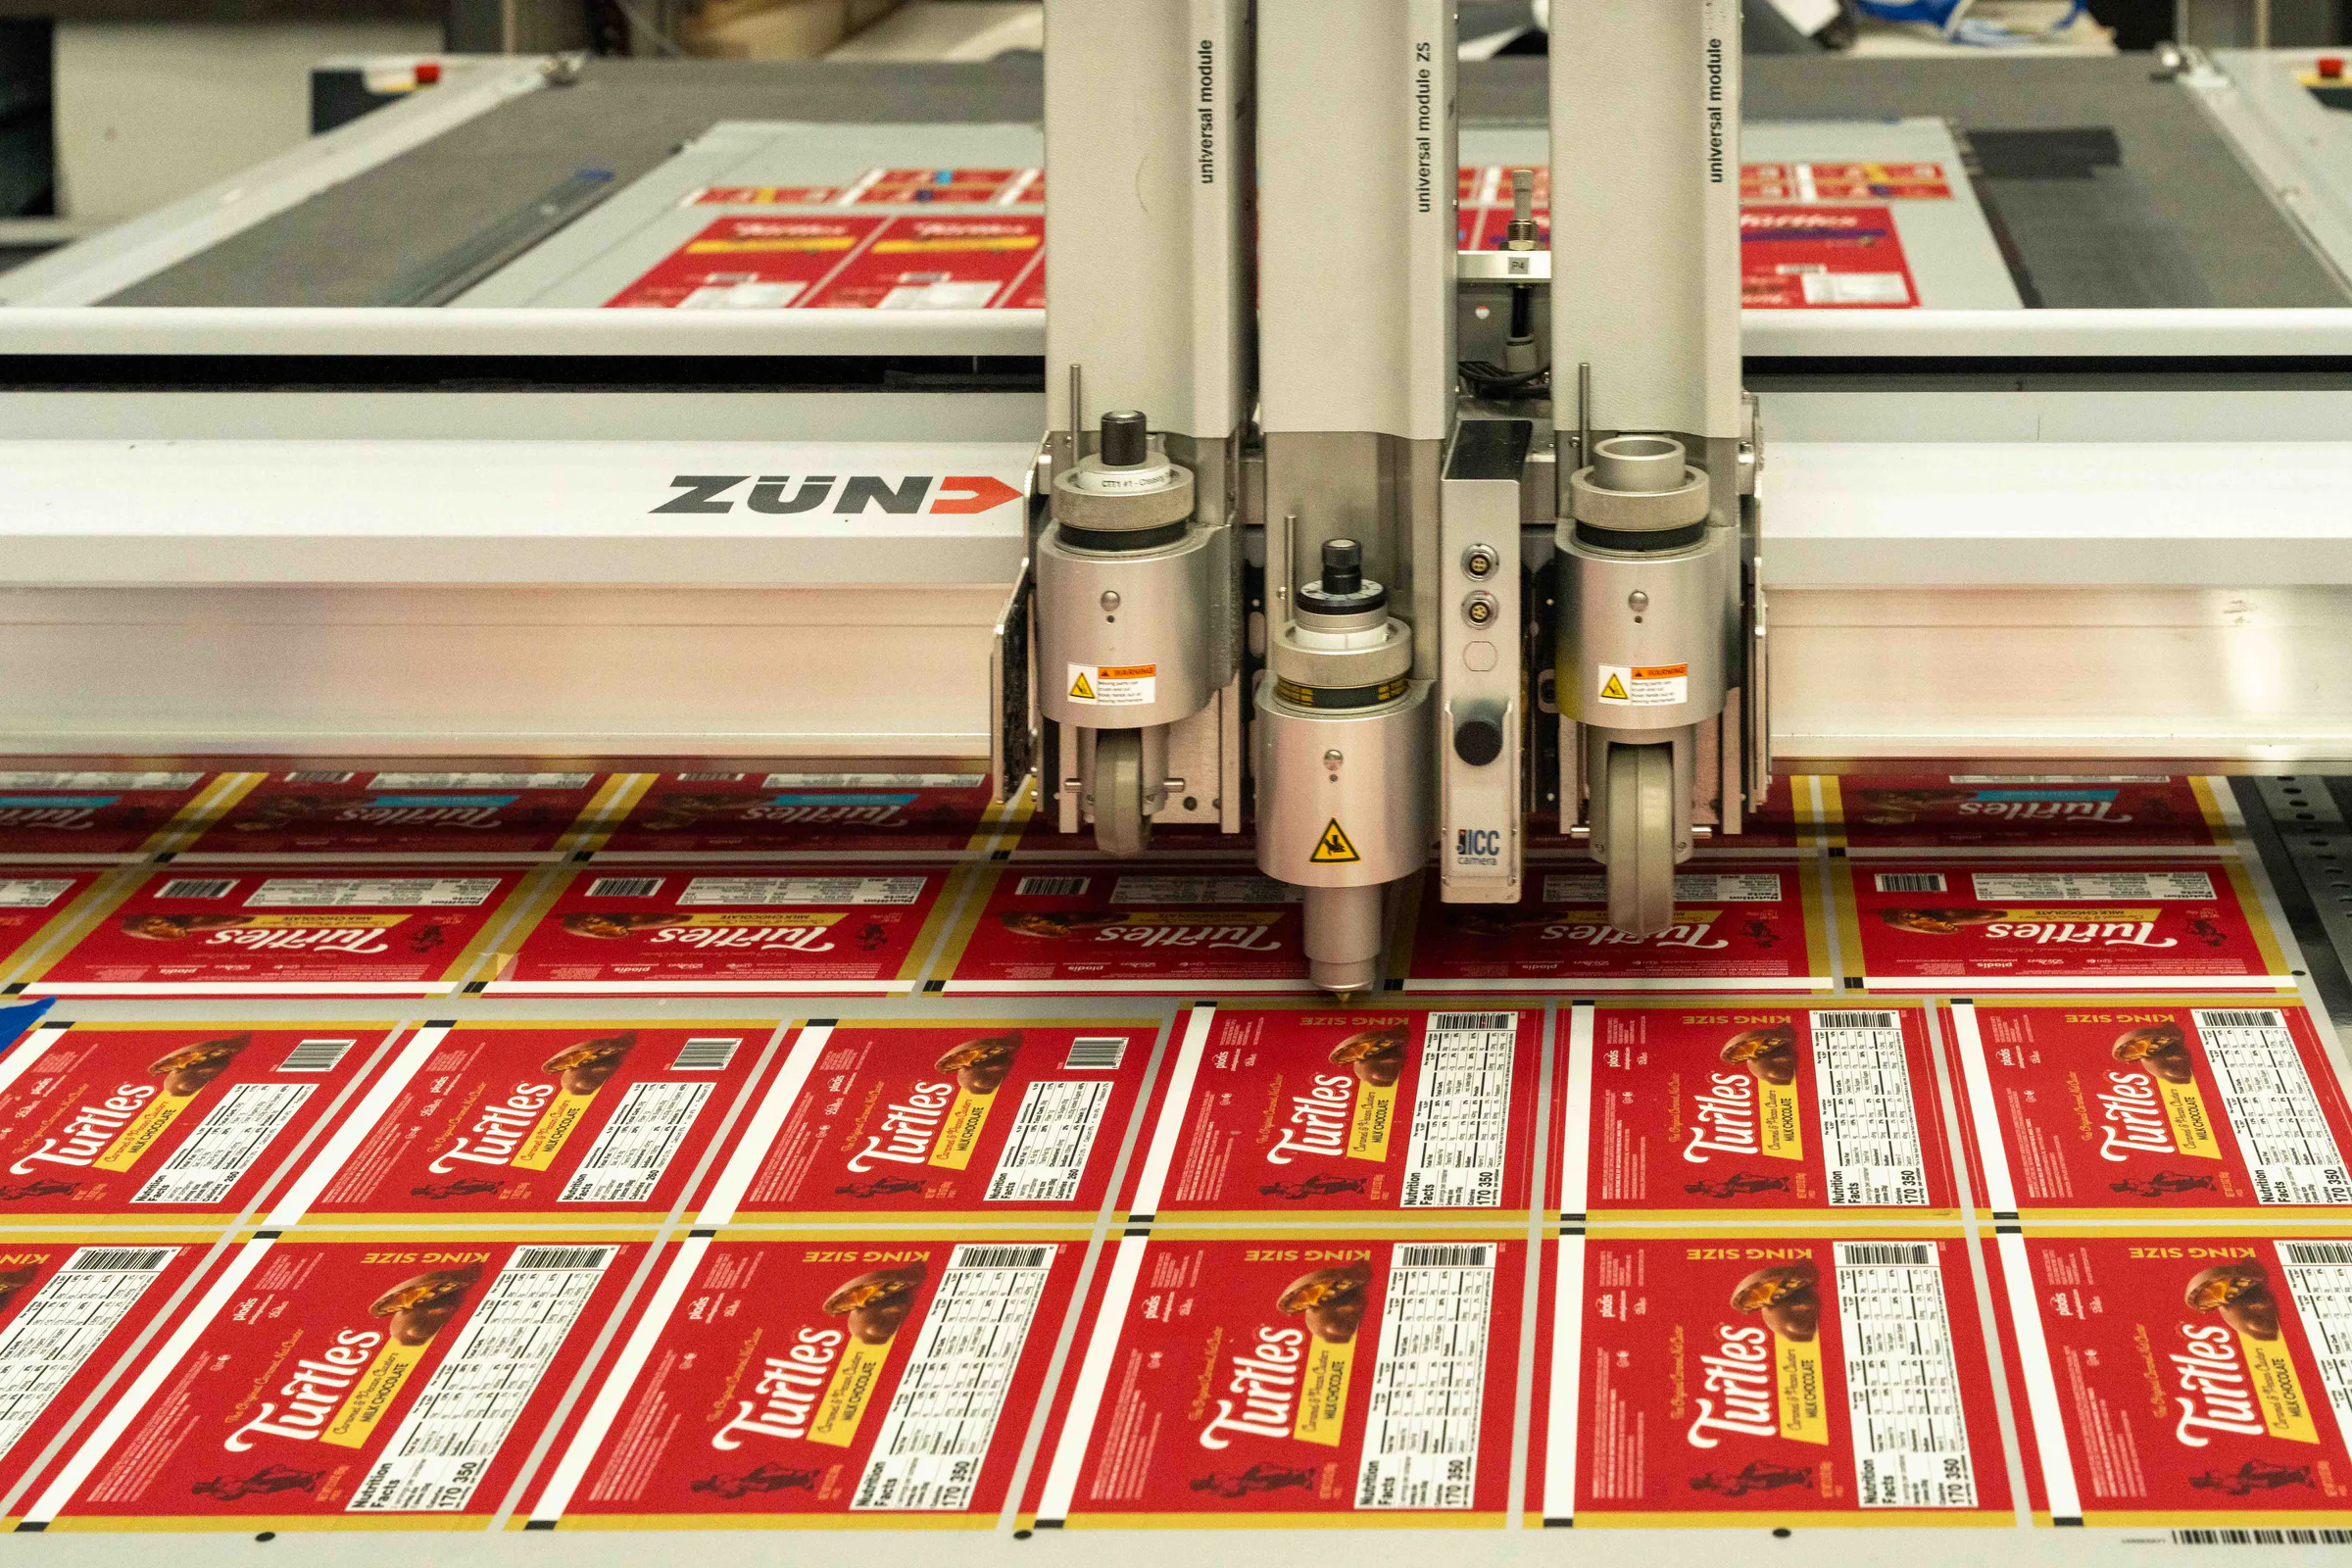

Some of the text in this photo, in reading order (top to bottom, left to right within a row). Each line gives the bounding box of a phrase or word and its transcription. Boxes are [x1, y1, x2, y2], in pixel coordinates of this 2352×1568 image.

[1198, 39, 1214, 184] universal module
[1707, 38, 1723, 183] universal module
[1416, 41, 1431, 213] universal module ZS
[1511, 261, 1525, 270] P4
[647, 475, 1025, 514] ZÜND
[1959, 801, 2133, 823] Turtles
[1457, 857, 1497, 865] camera
[205, 928, 389, 954] Turtles
[651, 927, 835, 952] Turtles
[1096, 926, 1282, 951] Turtles
[1985, 922, 2179, 948] Turtles
[10, 1085, 154, 1174] Turtles
[128, 1109, 175, 1152] MILK CHOCOLATE
[428, 1083, 553, 1173] Turtles
[543, 1108, 580, 1152] MILK CHOCOLATE
[847, 1082, 952, 1172] Turtles
[957, 1107, 984, 1151] MILK CHOCOLATE
[1267, 1075, 1351, 1163] Turtles
[1372, 1100, 1389, 1142] MILK CHOCOLATE
[1684, 1073, 1757, 1162] Turtles
[1781, 1098, 1793, 1141] MILK CHOCOLATE
[2097, 1072, 2174, 1160] Turtles
[2183, 1097, 2208, 1140] MILK CHOCOLATE
[135, 1175, 167, 1200] Nutrition
[223, 1171, 239, 1181] 260
[562, 1174, 587, 1200] Nutrition
[646, 1170, 659, 1180] 260
[989, 1173, 1007, 1199] Nutrition
[1067, 1169, 1078, 1179] 260
[1403, 1172, 1420, 1204] Nutrition
[1477, 1172, 1493, 1204] 170 350
[1830, 1171, 1844, 1203] Nutrition
[1900, 1170, 1918, 1202] 170 350
[2255, 1170, 2275, 1202] Nutrition
[2324, 1169, 2348, 1201] 170 350
[147, 1185, 170, 1200] Facts
[574, 1183, 593, 1200] Facts
[1001, 1182, 1015, 1199] Facts
[1419, 1184, 1434, 1204] Facts
[1847, 1183, 1860, 1202] Facts
[2274, 1181, 2290, 1201] Facts
[0, 1253, 51, 1265] KIN
[362, 1252, 490, 1263] KING SIZE
[804, 1251, 930, 1261] KING SIZE
[1246, 1250, 1370, 1260] KING SIZE
[1688, 1249, 1812, 1259] KING SIZE
[2129, 1248, 2255, 1257] KING SIZE
[224, 1330, 380, 1450] Turtles
[360, 1363, 409, 1421] MILK CHOCOLATE
[712, 1328, 841, 1449] Turtles
[841, 1362, 876, 1420] MILK CHOCOLATE
[1200, 1327, 1302, 1448] Turtles
[1688, 1326, 1775, 1446] Turtles
[1801, 1359, 1817, 1417] MILK CHOCOLATE
[2170, 1325, 2263, 1446] Turtles
[2271, 1358, 2301, 1416] MILK CHOCOLATE
[351, 1463, 393, 1507] Nutrition
[369, 1479, 400, 1507] Facts
[437, 1462, 476, 1507] 170 350
[855, 1461, 886, 1506] Nutrition
[873, 1478, 898, 1506] Facts
[941, 1461, 970, 1506] 170 350
[1860, 1459, 1878, 1503] Nutrition
[1881, 1475, 1896, 1503] Facts
[1943, 1458, 1964, 1503] 170 350
